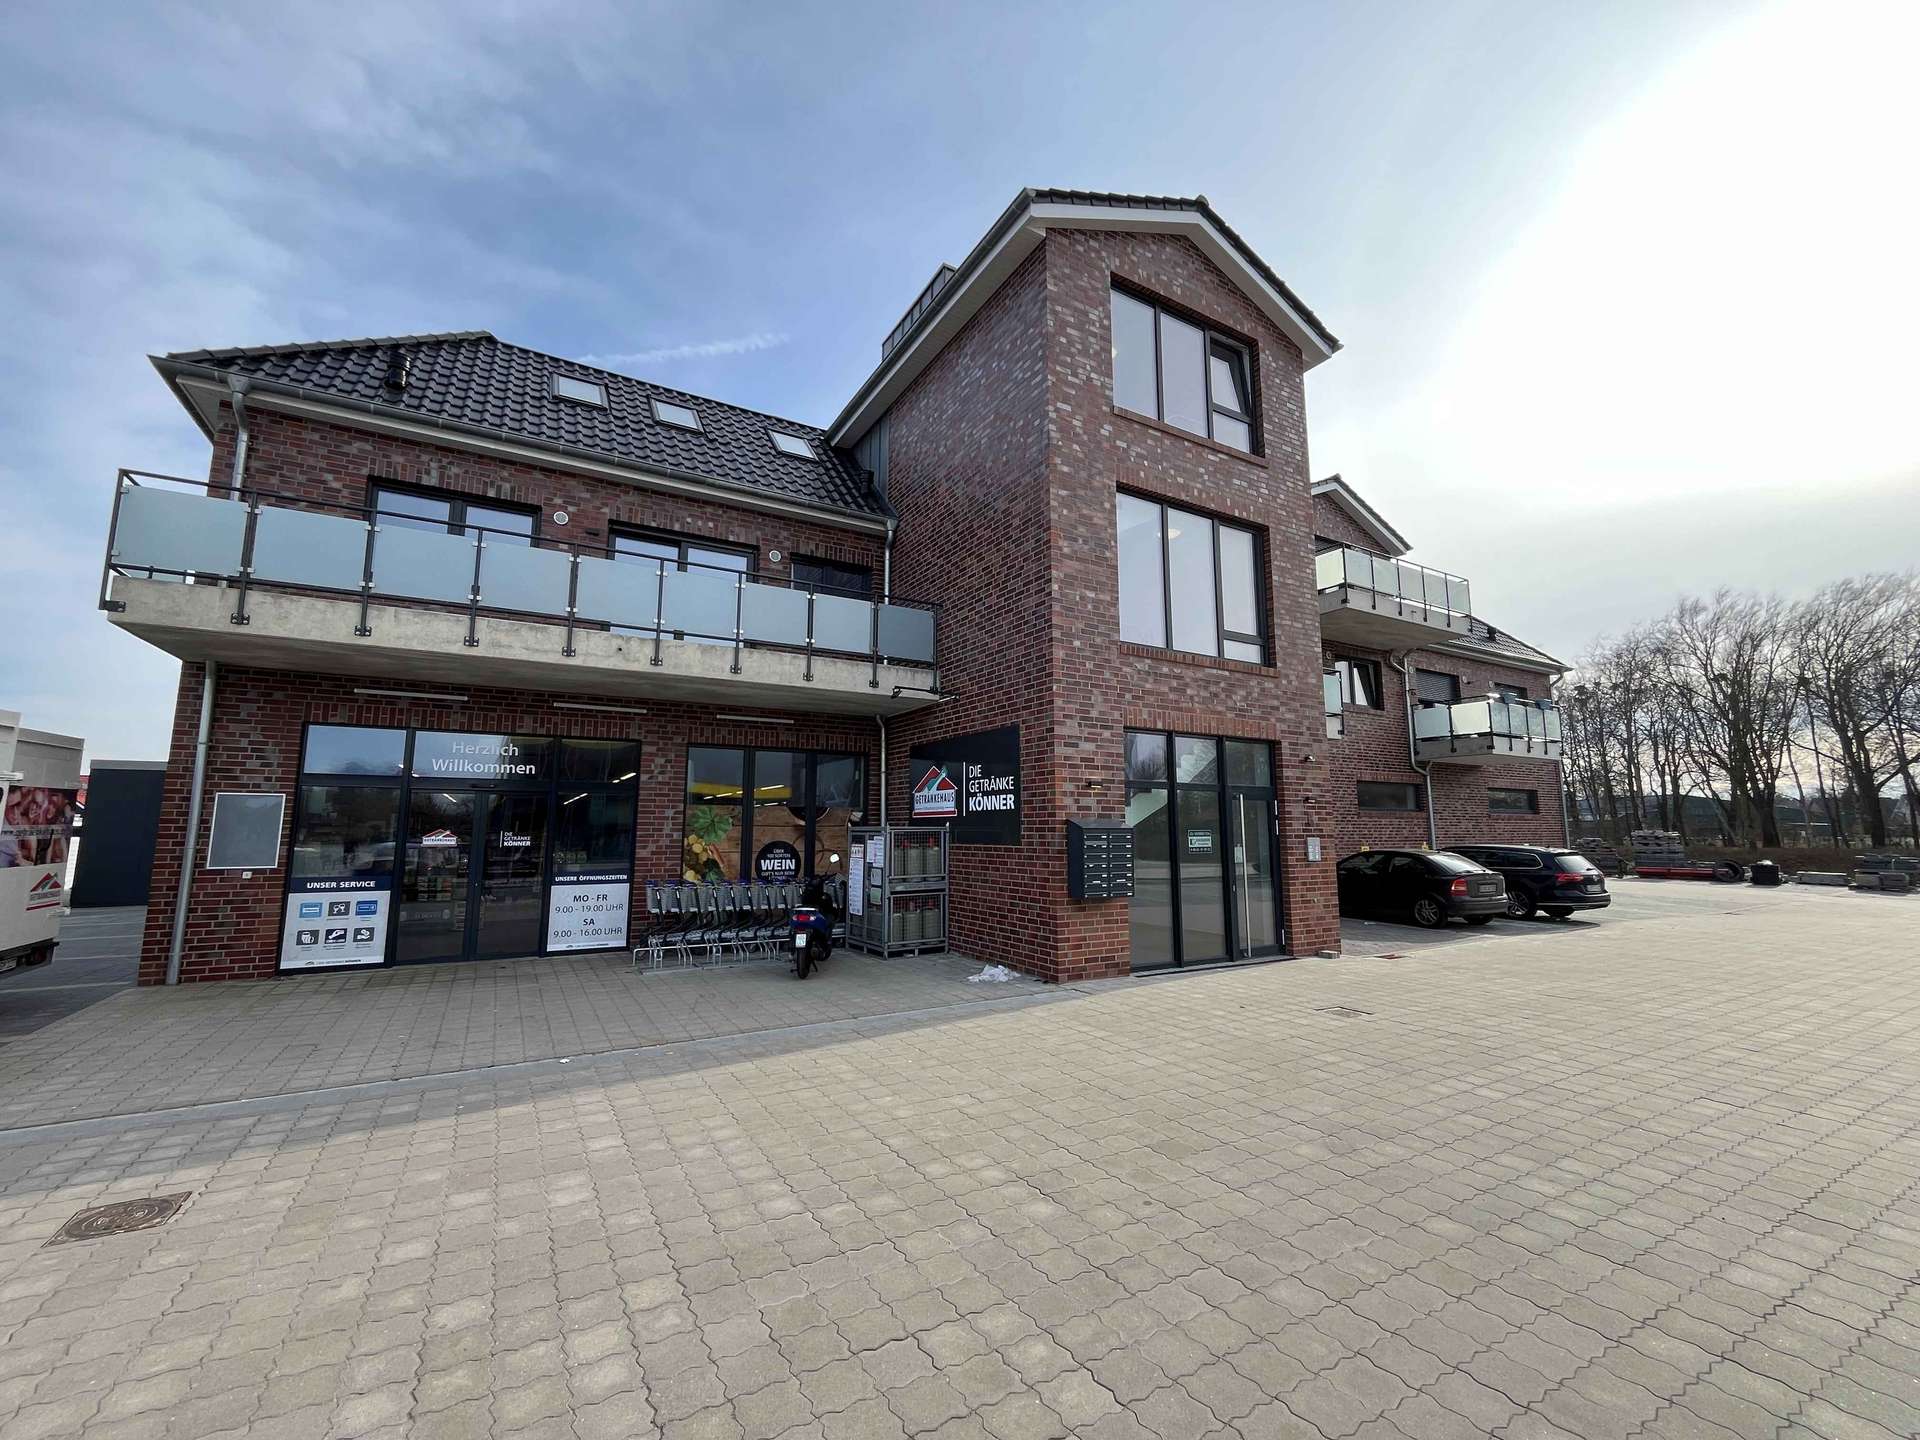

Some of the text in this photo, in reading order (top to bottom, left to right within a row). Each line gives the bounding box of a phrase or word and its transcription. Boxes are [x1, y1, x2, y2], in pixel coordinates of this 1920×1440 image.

[452, 741, 519, 756] Herzlich
[432, 759, 536, 774] Willkommen
[969, 764, 982, 778] DIE
[969, 776, 1015, 793] GETRÄNKE
[969, 793, 1015, 812] KÖNNER
[760, 859, 796, 870] WEIN
[340, 880, 376, 888] SERVICE
[573, 894, 589, 902] MO
[581, 904, 604, 912] 19.00
[606, 903, 624, 911] UHR
[583, 918, 595, 926] SA
[553, 930, 572, 938] 9.00
[580, 928, 602, 936] 16.00
[604, 927, 623, 935] UHR
